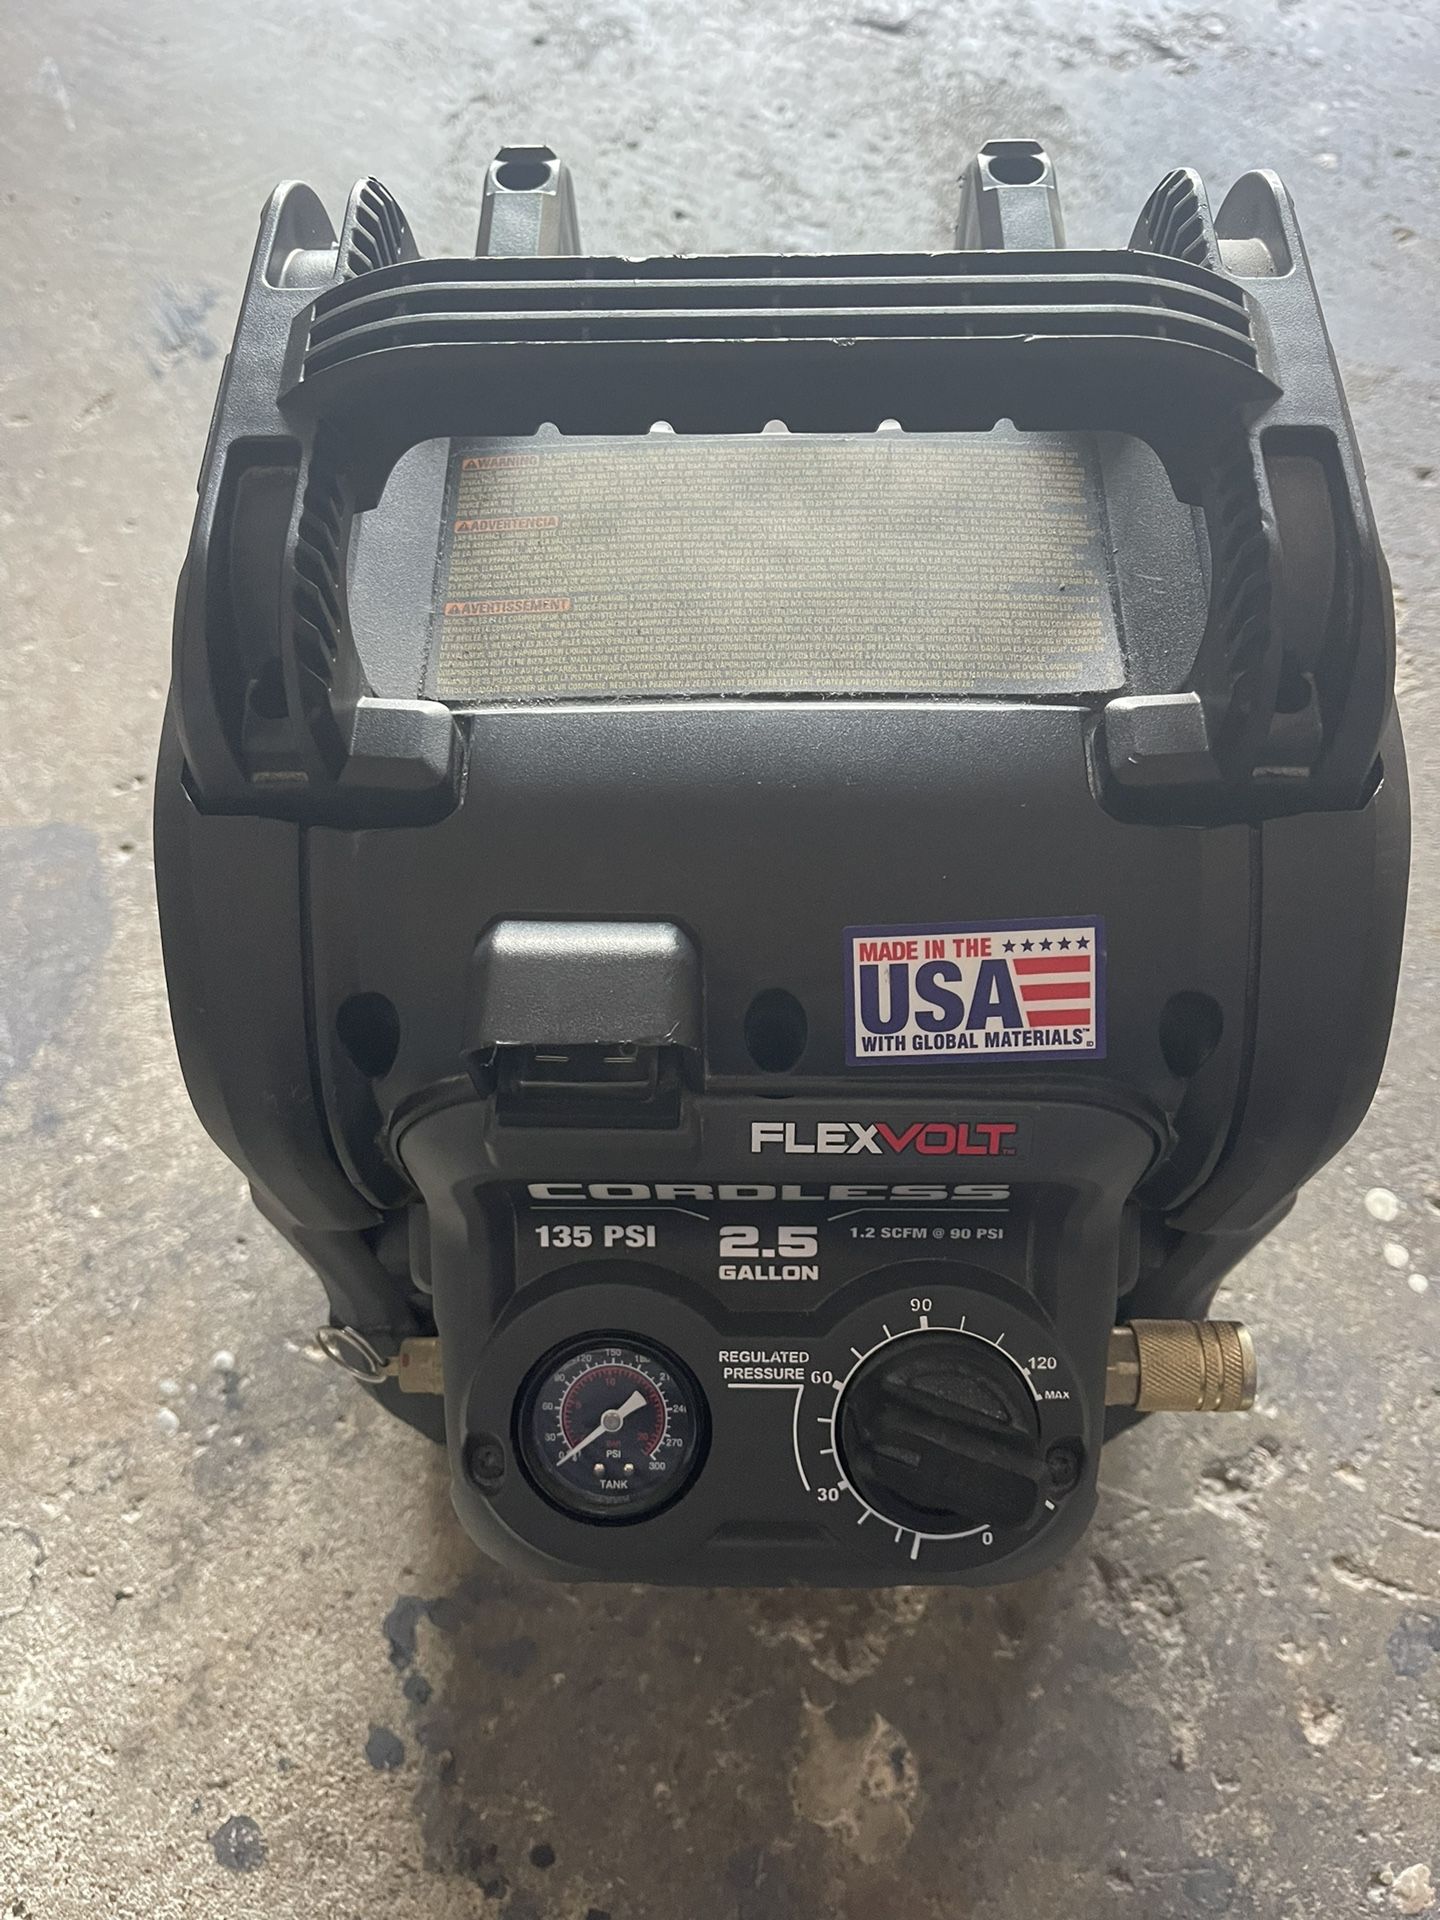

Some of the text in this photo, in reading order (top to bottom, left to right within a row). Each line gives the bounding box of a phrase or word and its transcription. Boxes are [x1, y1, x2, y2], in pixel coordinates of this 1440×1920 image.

[478, 456, 538, 468] WARNING
[471, 516, 556, 531] ADVERTENCIA
[462, 600, 567, 614] AVERTISSEMENT
[859, 937, 992, 961] MADE IN THE
[859, 958, 1024, 1035] USA
[862, 1035, 906, 1052] WITH
[912, 1032, 979, 1050] GLOBAL
[527, 1183, 1012, 1201] CORDLESS
[535, 1225, 657, 1248] 135 PSI
[850, 1226, 1004, 1240] 1.2 SCFM @ 90 PSI
[718, 1225, 818, 1258] 2.5
[718, 1264, 819, 1281] GALLON
[910, 1298, 933, 1312] 90
[718, 1351, 810, 1364] REGULATED
[1028, 1356, 1057, 1370] 120
[723, 1367, 805, 1380] PRESSURE
[810, 1370, 833, 1385] 60
[1044, 1390, 1070, 1400] MAX
[666, 1439, 683, 1447] 270
[606, 1450, 621, 1458] PSI
[648, 1462, 666, 1471] 300
[599, 1480, 628, 1489] TANK
[817, 1488, 840, 1502] 30
[982, 1531, 994, 1546] 0
